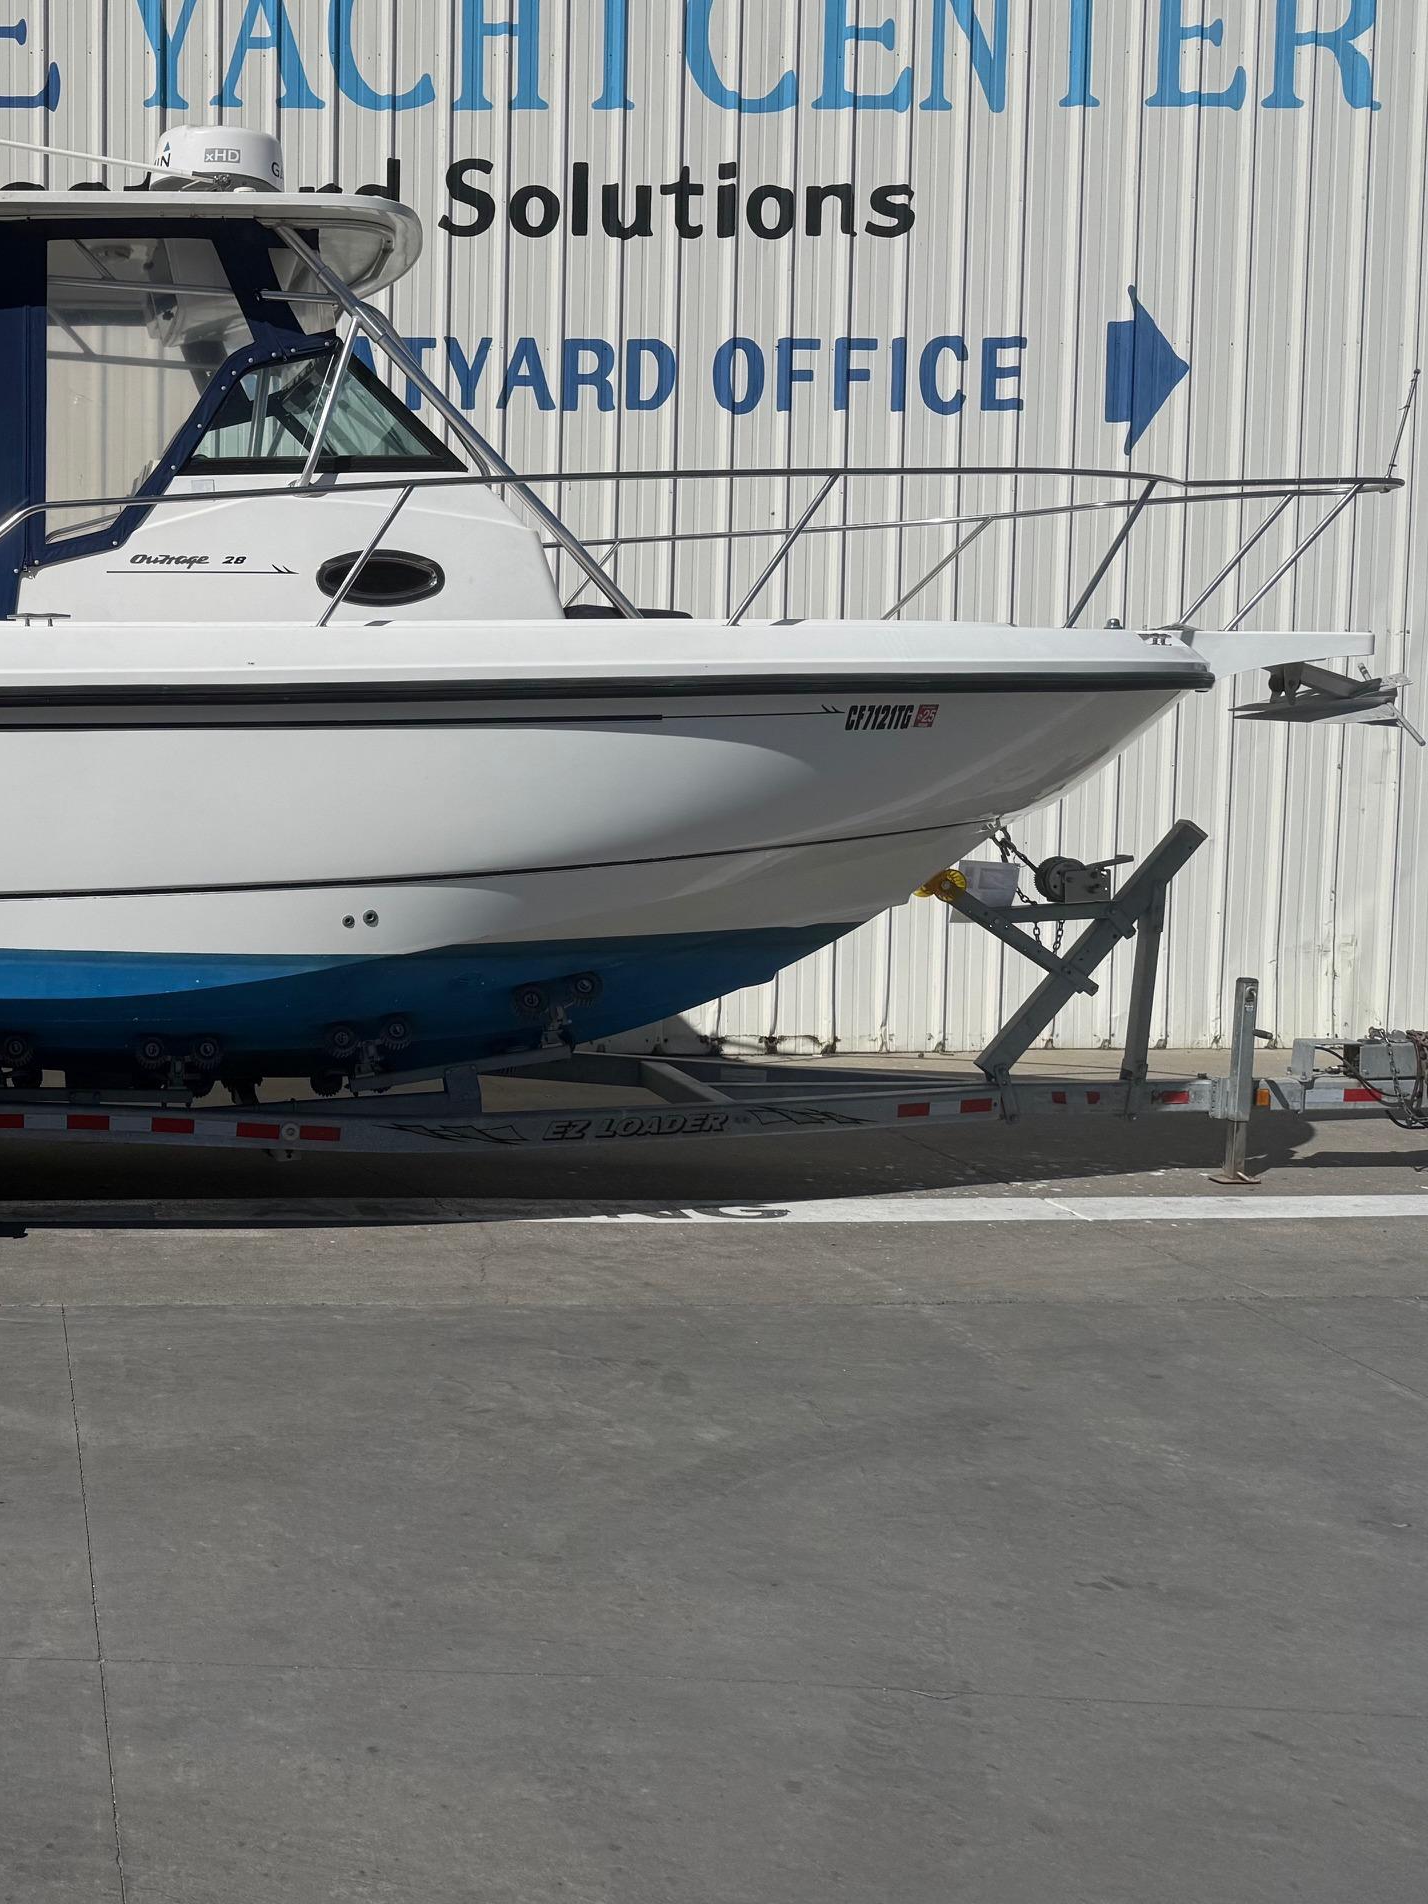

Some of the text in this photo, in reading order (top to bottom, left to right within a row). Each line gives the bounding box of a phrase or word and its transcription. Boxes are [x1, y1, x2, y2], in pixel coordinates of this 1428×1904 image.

[205, 150, 240, 162] xHD
[437, 158, 915, 240] Solutions
[712, 335, 1028, 415] OFFICE
[129, 554, 247, 569] Outrage 28
[542, 1112, 730, 1141] EZ LOADER
